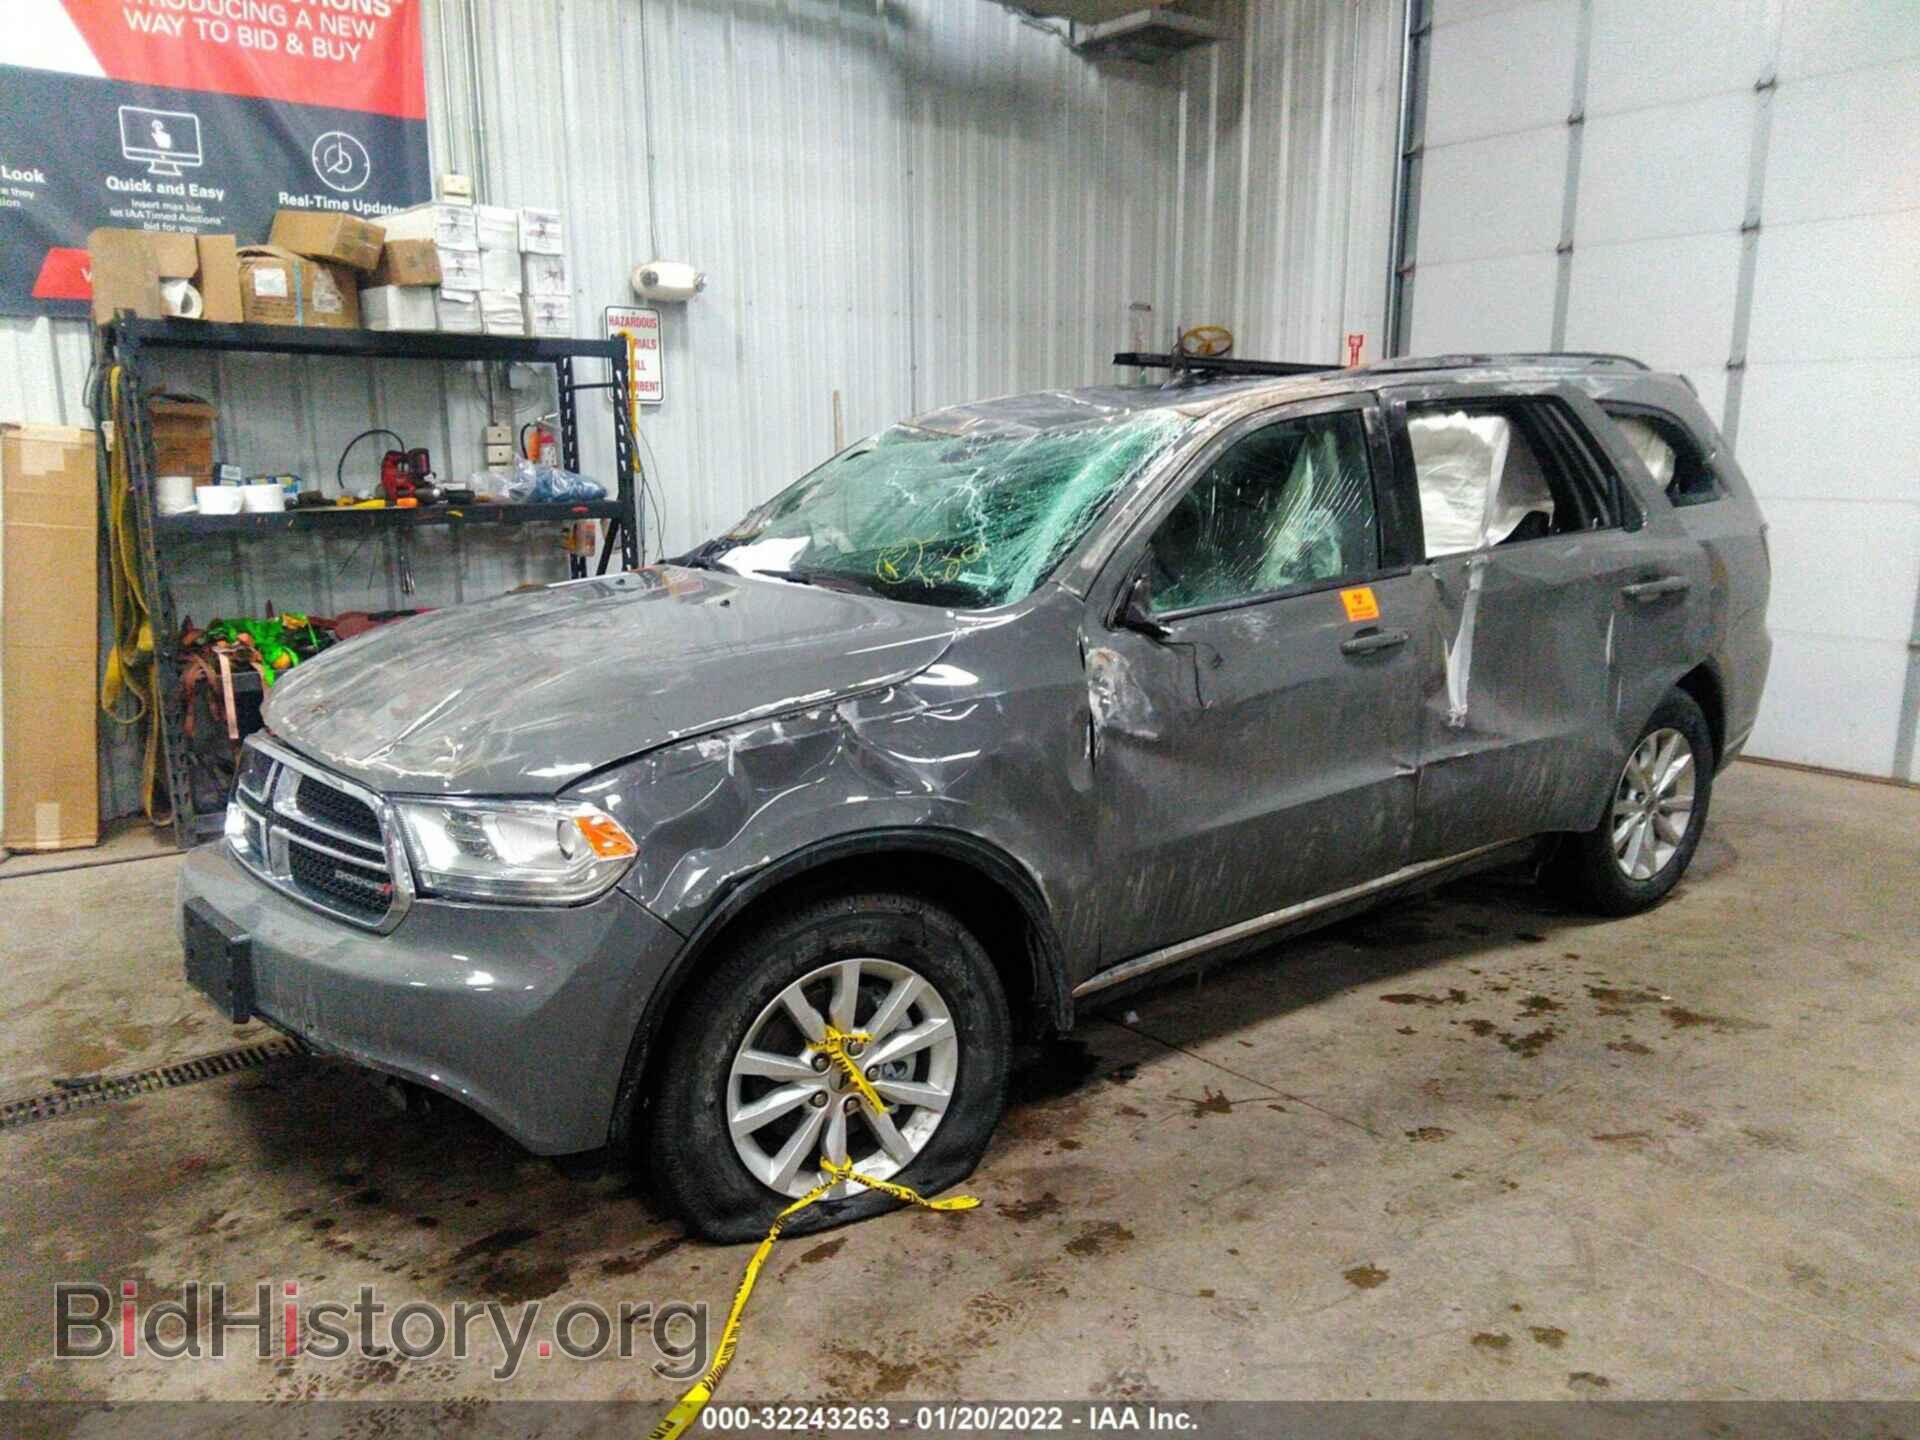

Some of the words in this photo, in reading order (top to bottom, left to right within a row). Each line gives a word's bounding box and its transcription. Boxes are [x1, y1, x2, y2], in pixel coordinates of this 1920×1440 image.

[122, 7, 185, 37] WAY
[193, 17, 229, 43] TO
[238, 26, 278, 50] BID
[286, 33, 304, 55] &
[312, 36, 361, 62] BUY
[295, 8, 312, 31] A
[320, 12, 375, 40] NEW
[1, 165, 47, 184] Look
[106, 176, 152, 193] Quick
[156, 183, 185, 196] and
[189, 184, 224, 202] Easy
[278, 192, 349, 211] Real-Time
[609, 316, 657, 328] HAZARDOUS
